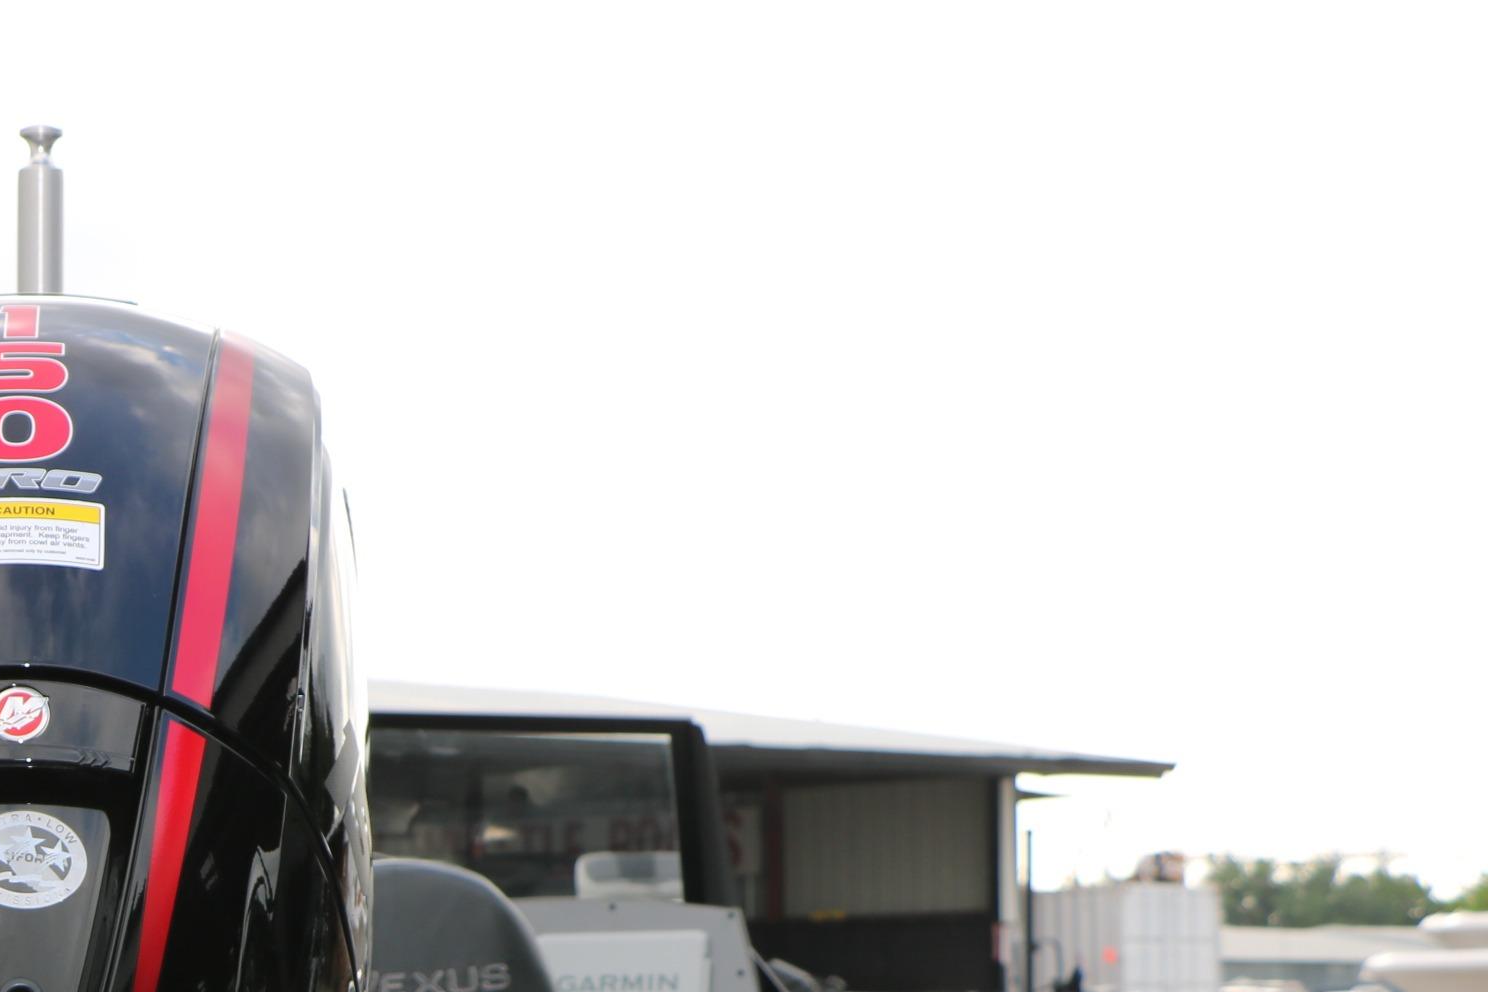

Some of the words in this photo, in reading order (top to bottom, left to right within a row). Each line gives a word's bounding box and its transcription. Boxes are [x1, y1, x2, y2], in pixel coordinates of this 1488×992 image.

[9, 524, 32, 532] injury
[56, 525, 78, 534] finger
[8, 537, 28, 545] from
[38, 532, 61, 540] Keep
[62, 533, 90, 543] fingers
[45, 818, 78, 845] LOW
